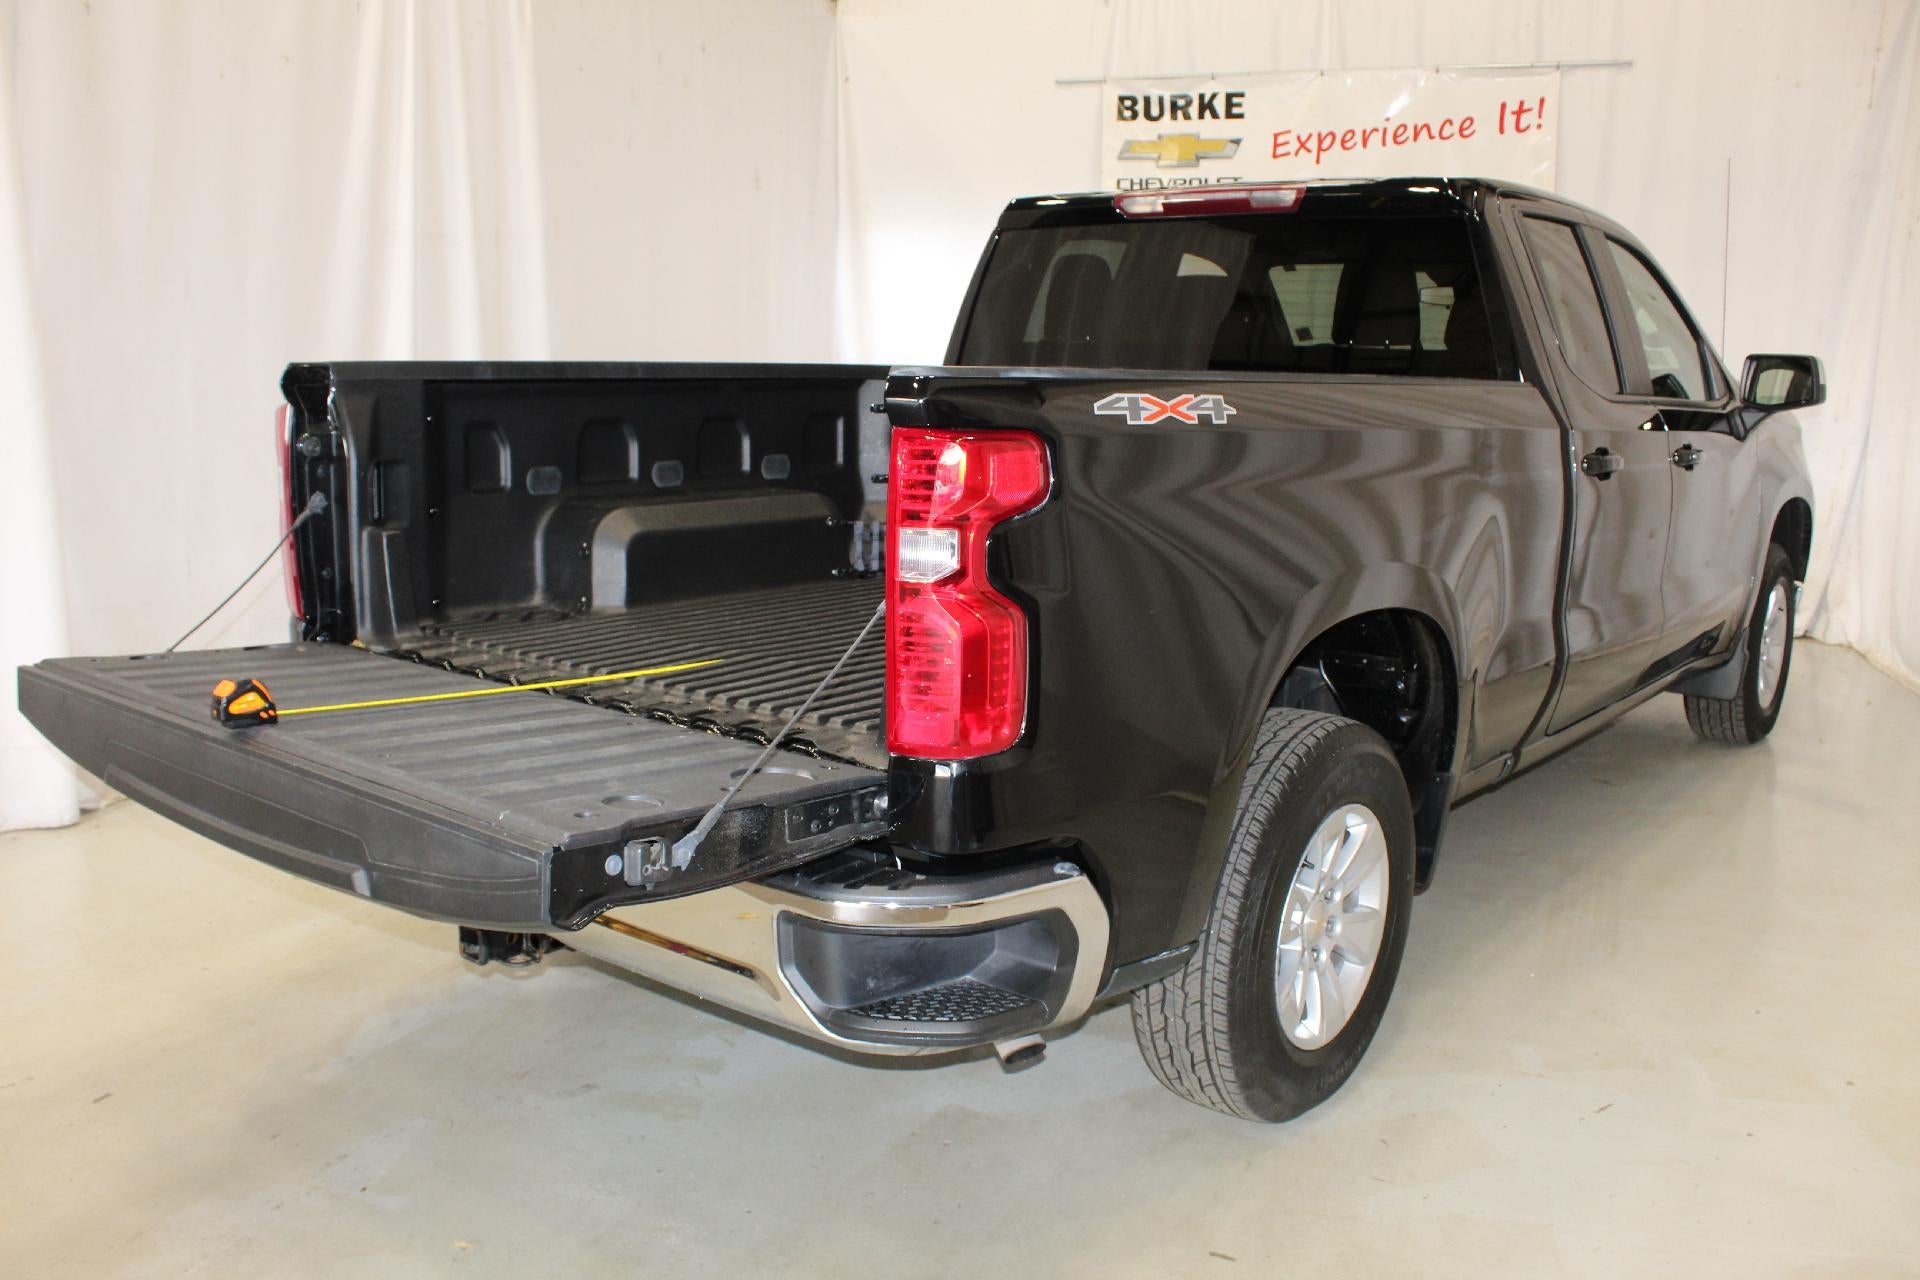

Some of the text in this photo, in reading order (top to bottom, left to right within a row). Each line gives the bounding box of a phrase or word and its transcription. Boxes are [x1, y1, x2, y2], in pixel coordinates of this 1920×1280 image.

[1117, 91, 1246, 122] BURKE
[1272, 96, 1546, 165] Experience It!
